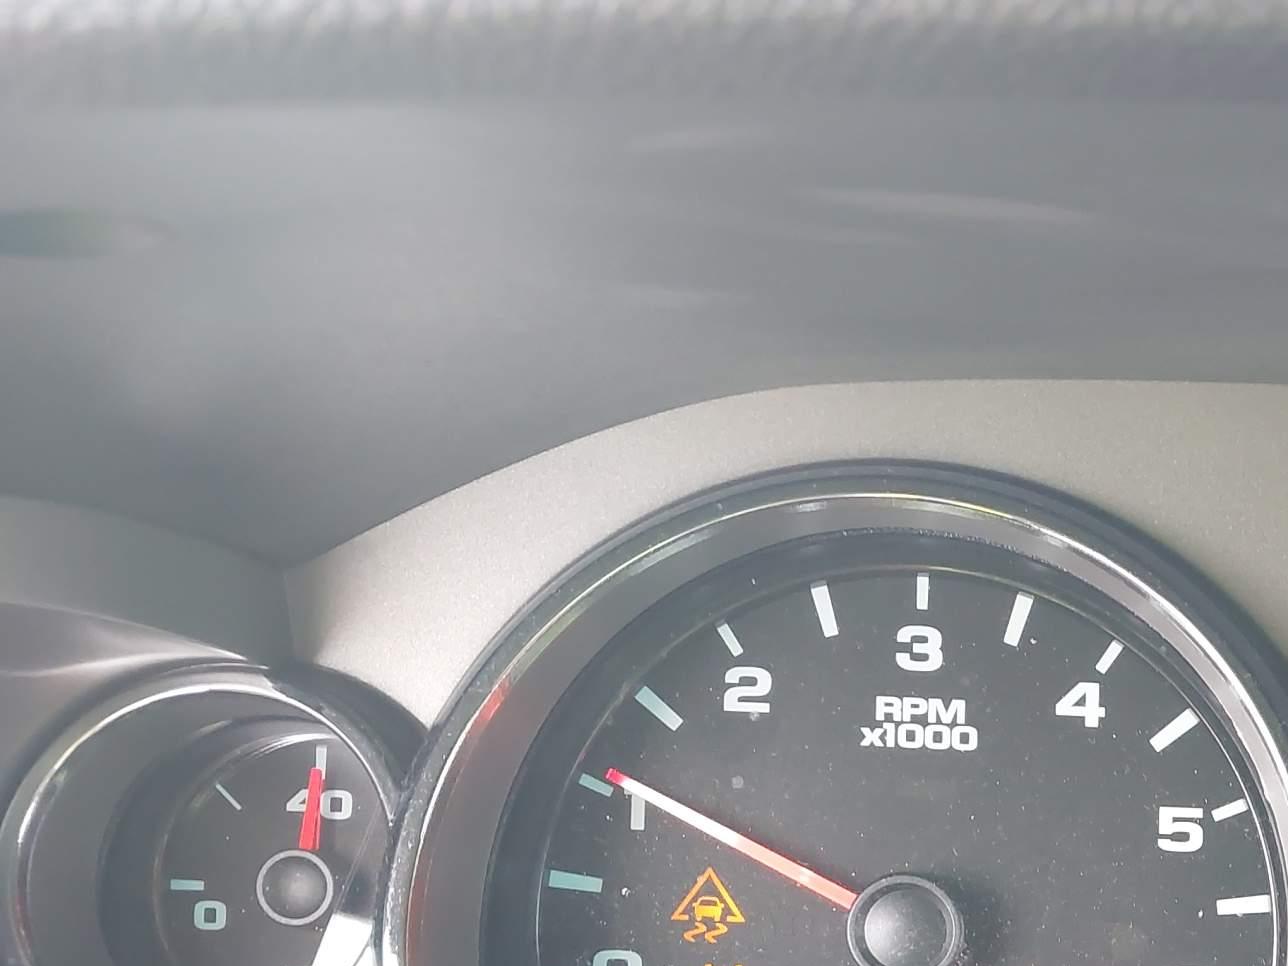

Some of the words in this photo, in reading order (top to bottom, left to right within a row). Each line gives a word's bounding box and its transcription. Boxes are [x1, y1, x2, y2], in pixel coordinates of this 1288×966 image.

[895, 625, 944, 672] 3
[723, 666, 773, 714] 2
[874, 695, 967, 725] RPM
[1055, 682, 1106, 728] 4
[860, 723, 979, 752] x1000
[1157, 806, 1204, 853] 5
[193, 900, 227, 931] 0
